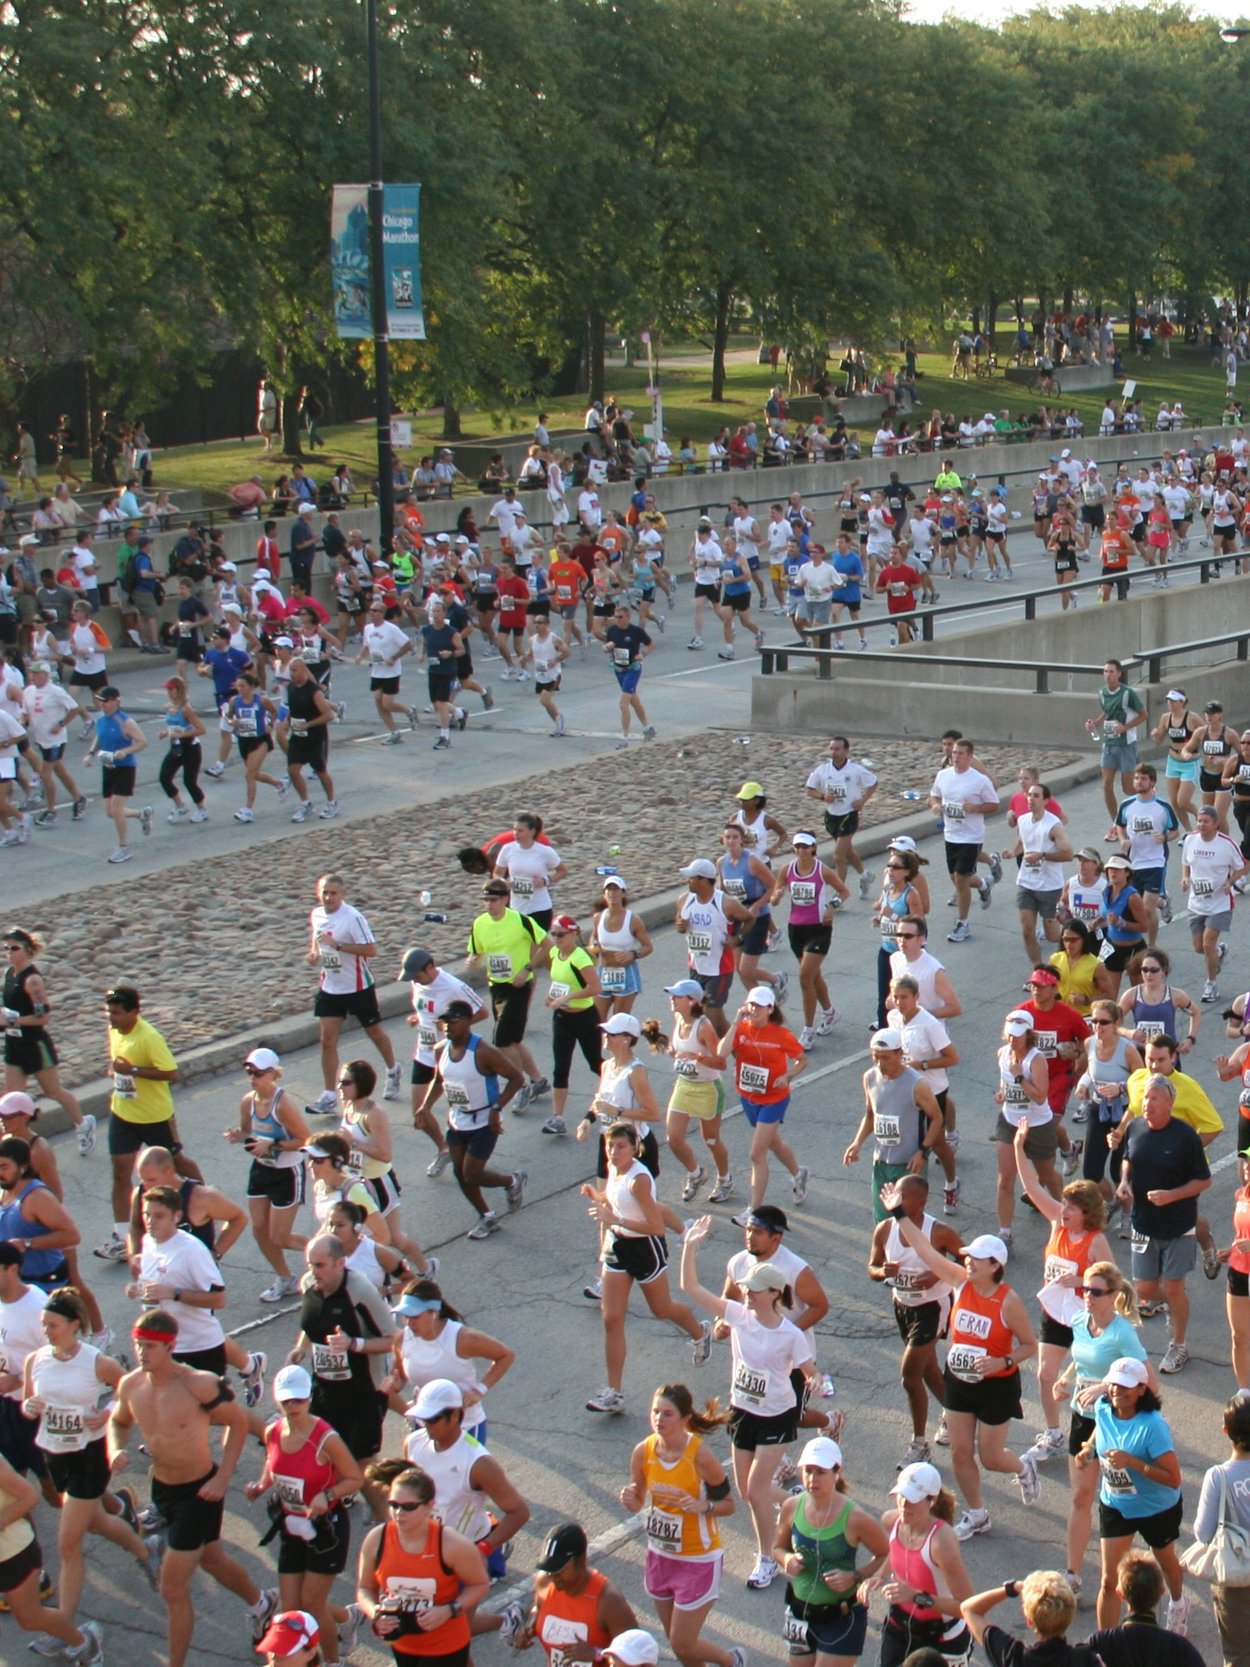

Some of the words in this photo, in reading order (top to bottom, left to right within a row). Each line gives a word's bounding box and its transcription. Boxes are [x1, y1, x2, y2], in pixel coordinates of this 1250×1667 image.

[383, 214, 413, 230] Chicago
[383, 230, 419, 244] Marathon
[1194, 849, 1215, 858] LIBERTY
[1037, 1038, 1055, 1050] 822
[957, 1313, 987, 1336] FRAN
[949, 1352, 979, 1370] 3563
[736, 1369, 765, 1394] 34330
[46, 1411, 82, 1429] 34164
[645, 1516, 679, 1538] 18787
